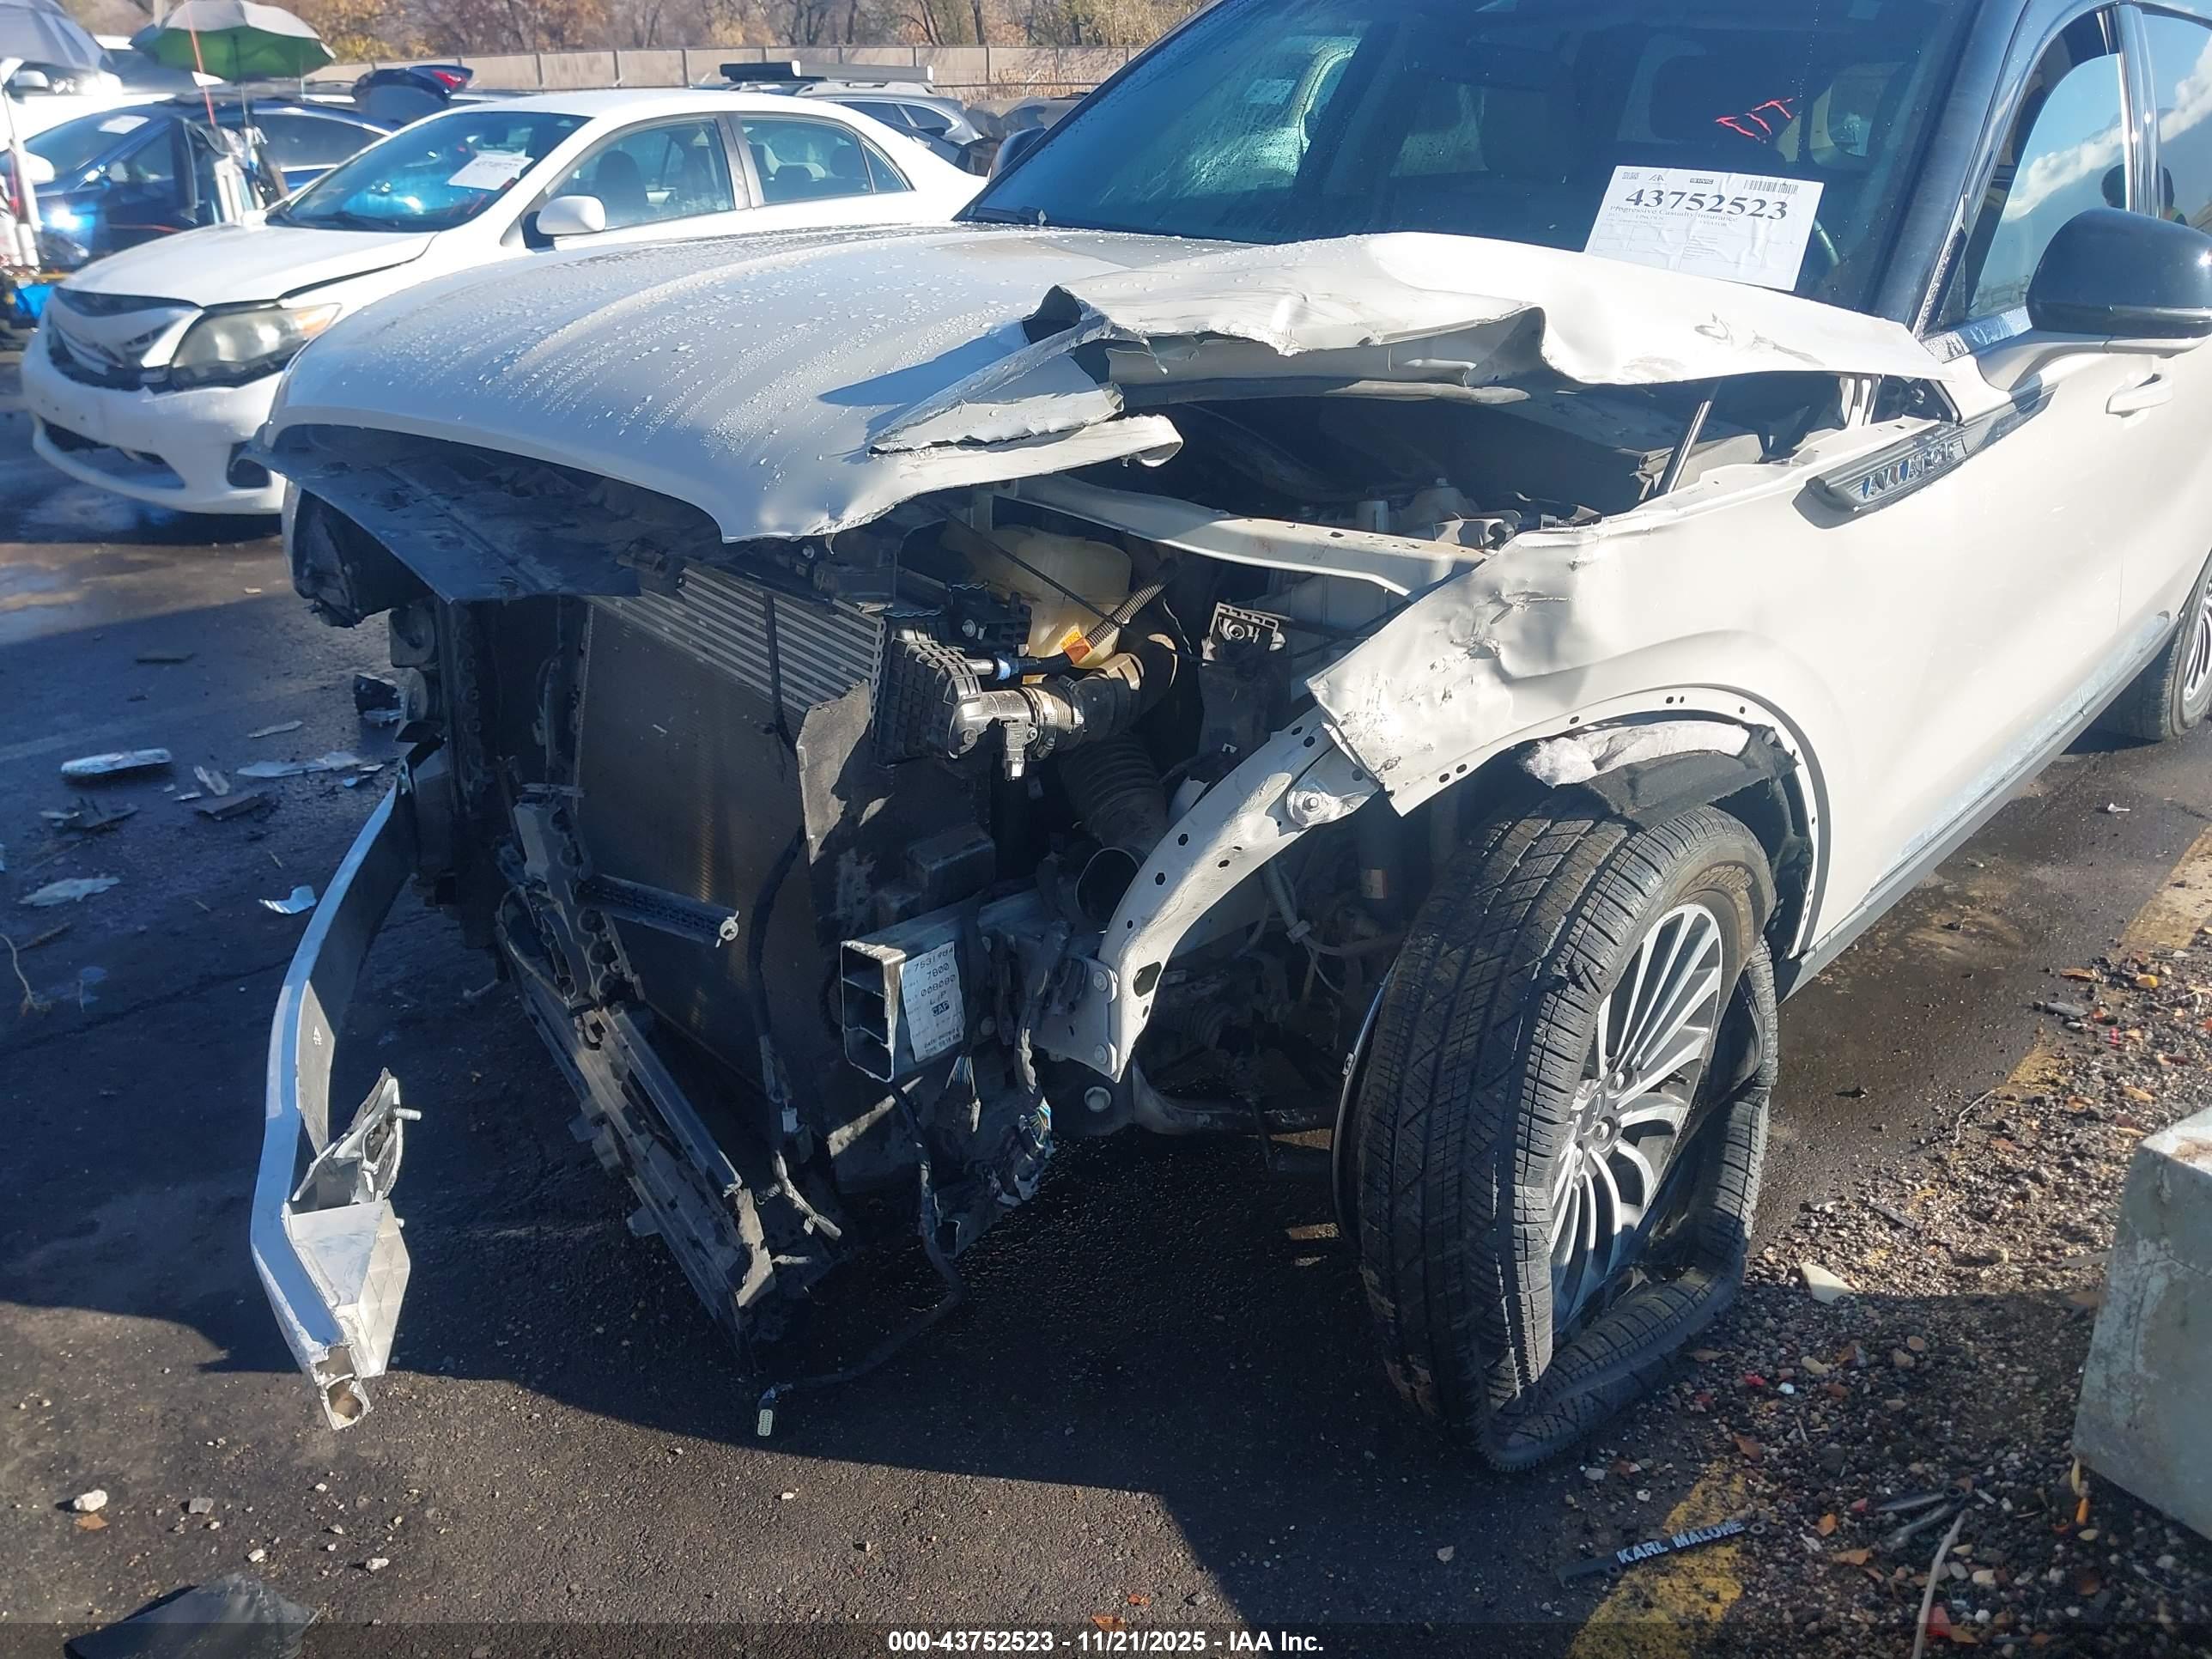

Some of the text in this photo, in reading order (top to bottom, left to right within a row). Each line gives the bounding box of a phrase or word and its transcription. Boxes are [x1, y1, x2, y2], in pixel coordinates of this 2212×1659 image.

[1609, 204, 1657, 216] Progressive
[1625, 188, 1789, 221] 43752523
[1616, 1519, 1746, 1564] KARL MALONE
